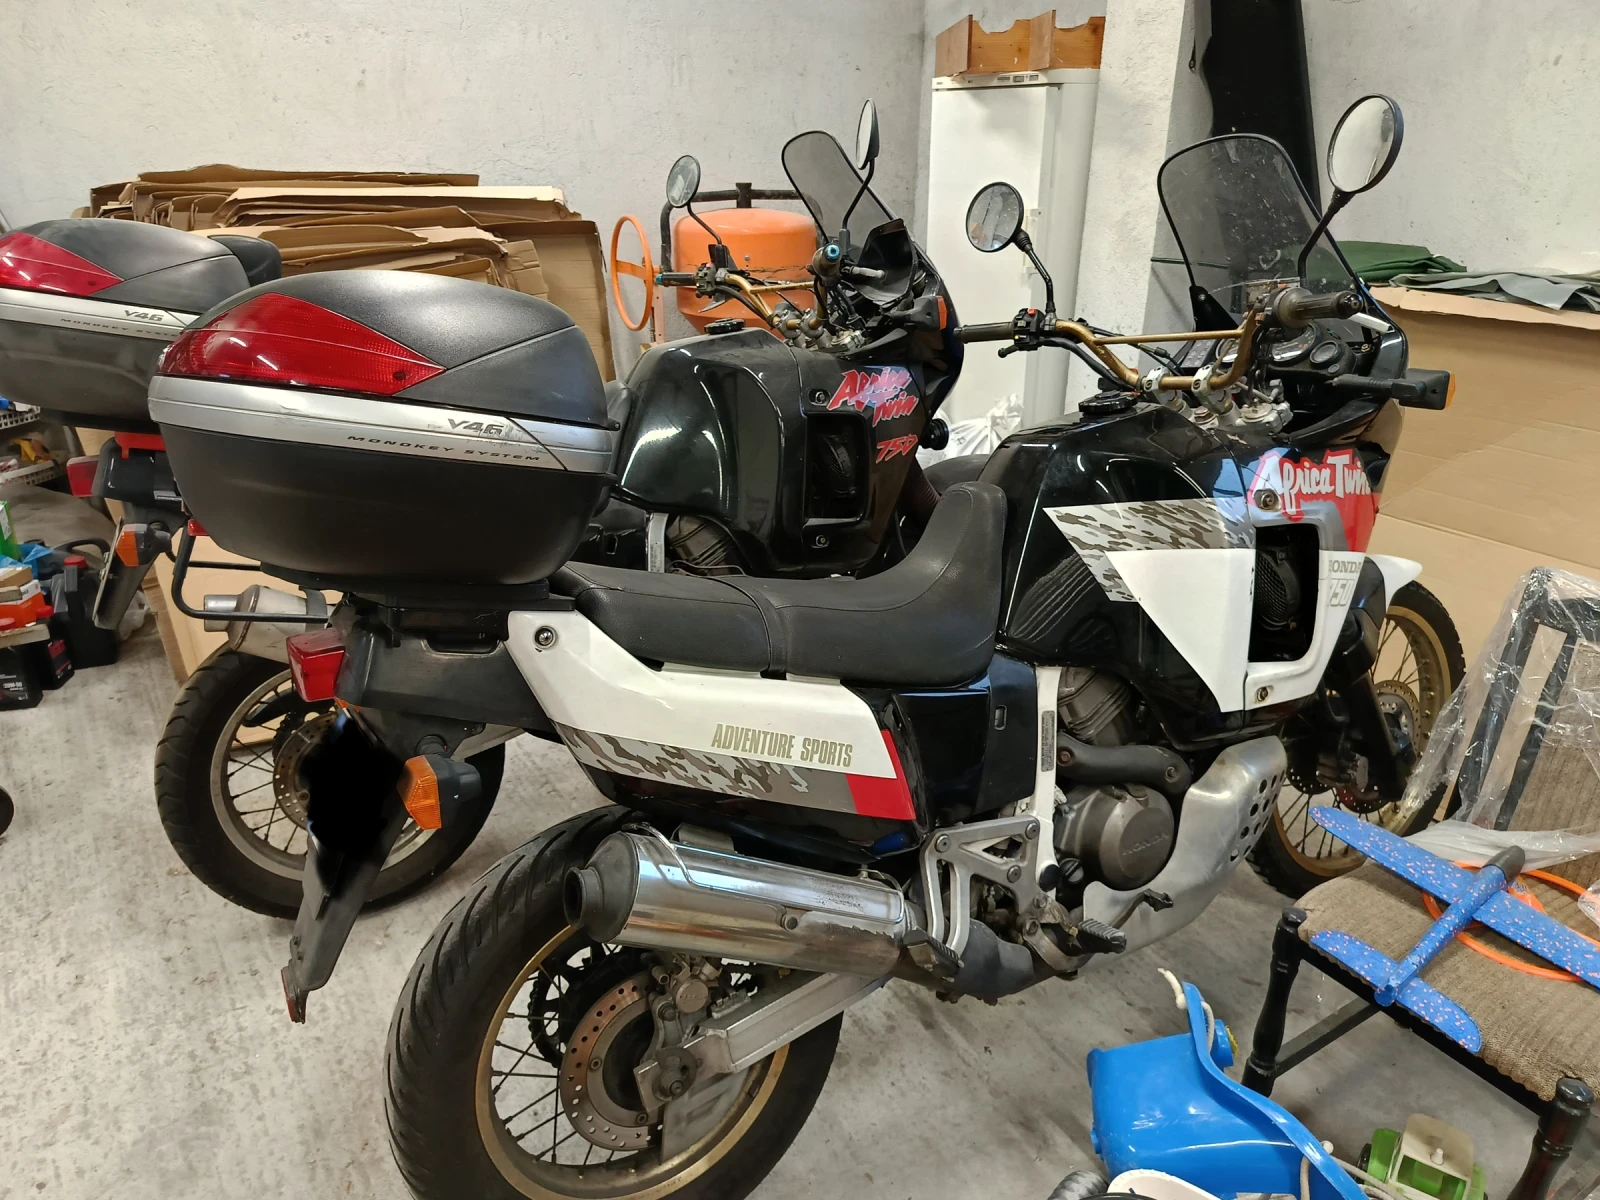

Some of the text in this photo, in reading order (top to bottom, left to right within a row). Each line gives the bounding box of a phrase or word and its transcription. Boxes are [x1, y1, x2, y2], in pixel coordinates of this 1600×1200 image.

[60, 318, 129, 331] MONOKEY
[124, 309, 165, 322] V46
[447, 418, 504, 436] V46
[347, 435, 540, 462] MONOKEY SYSTEM
[876, 434, 919, 464] 750
[1250, 452, 1335, 516] Africa
[711, 723, 853, 768] ADVENTURE SPORTS
